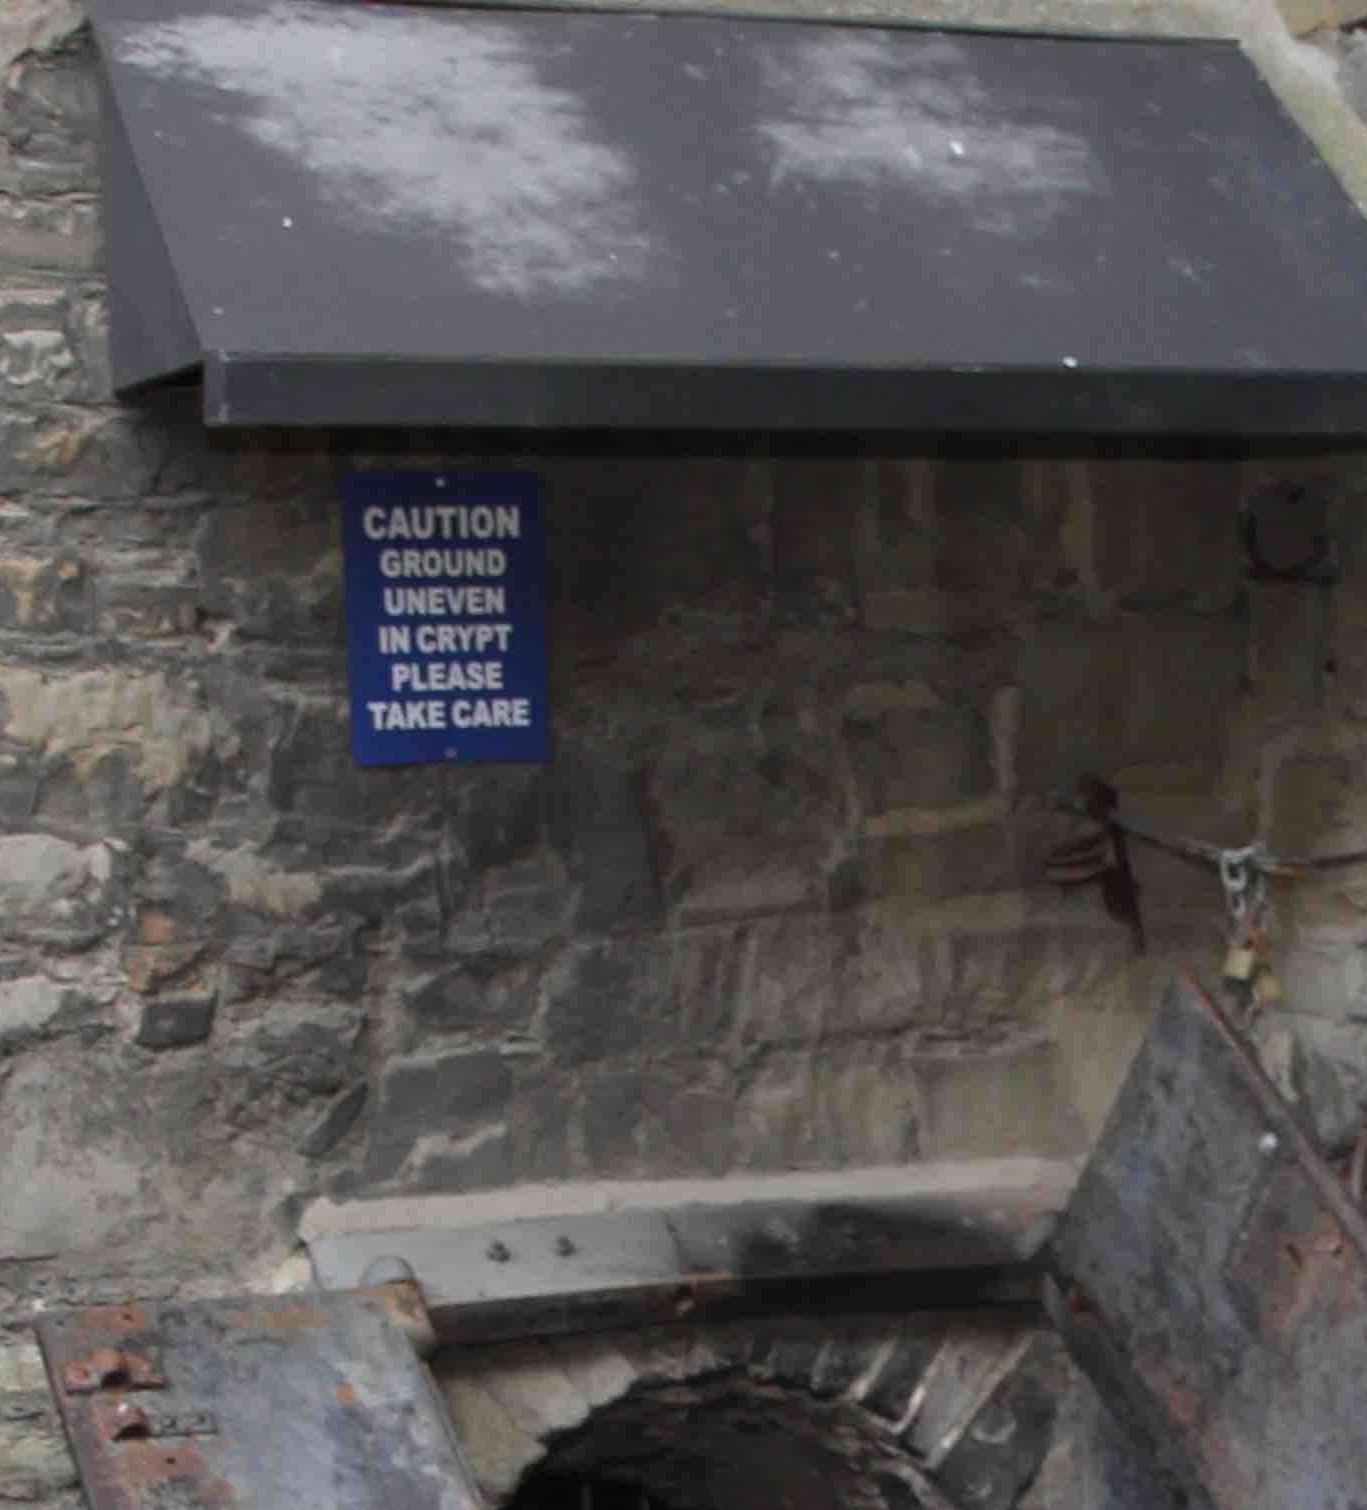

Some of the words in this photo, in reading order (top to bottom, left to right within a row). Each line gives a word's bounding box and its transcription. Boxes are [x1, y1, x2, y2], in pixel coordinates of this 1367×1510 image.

[362, 506, 521, 540] CAUTION
[380, 549, 506, 577] GROUND
[384, 587, 506, 615] UNEVEN
[378, 625, 410, 654] IN
[416, 624, 512, 653] CRYPT
[391, 662, 504, 691] PLEASE
[367, 702, 446, 731] TAKE
[451, 699, 530, 728] CARE
